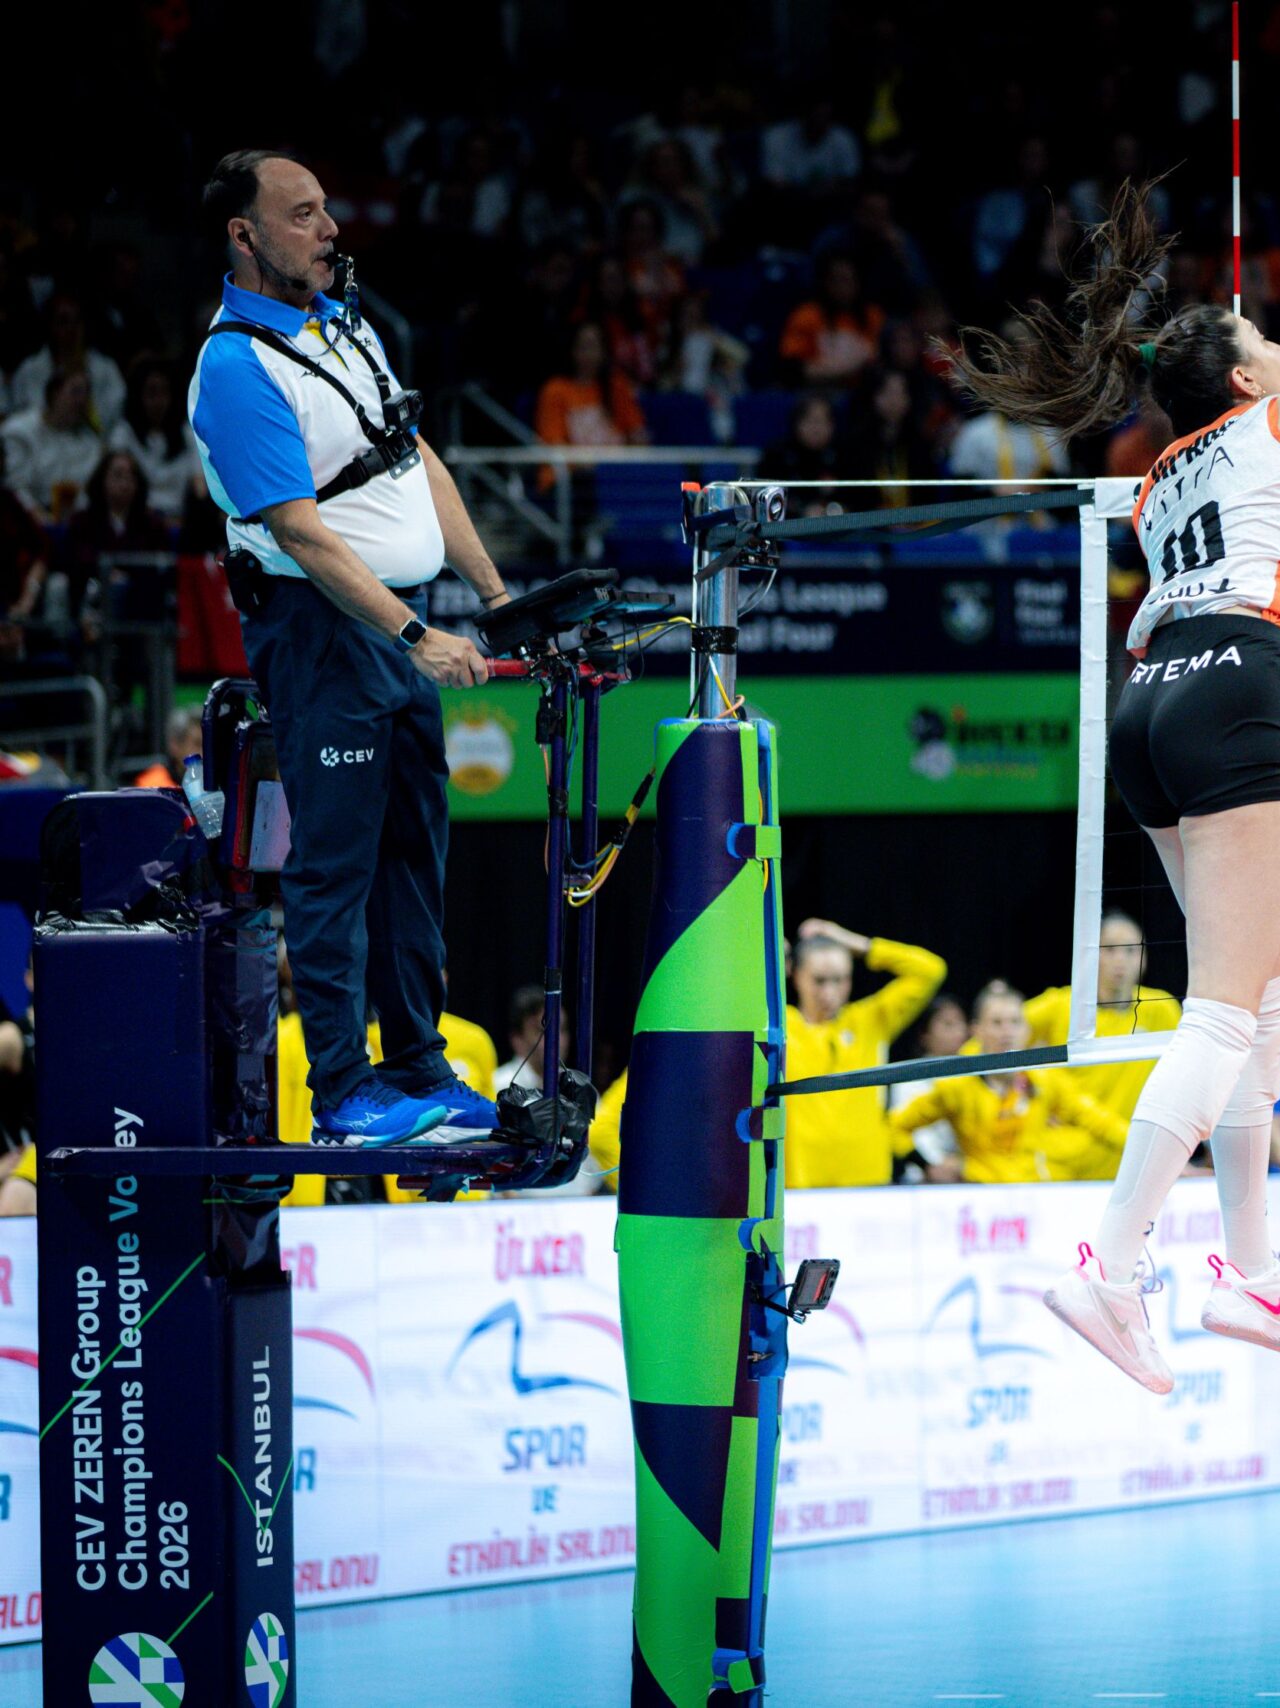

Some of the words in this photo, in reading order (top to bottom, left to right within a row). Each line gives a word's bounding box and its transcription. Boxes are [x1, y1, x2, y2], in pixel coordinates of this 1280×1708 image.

[1130, 645, 1242, 685] RTEMA
[343, 747, 374, 764] CEV
[108, 1106, 145, 1223] Voey
[70, 1265, 107, 1380] Group
[112, 1231, 149, 1369] League
[72, 1389, 105, 1504] ZEREN
[113, 1380, 153, 1591] Champions
[252, 1345, 274, 1568] ISTANBUL
[76, 1513, 107, 1591] CEV
[157, 1500, 190, 1590] 2026
[293, 1552, 381, 1595] ALONU
